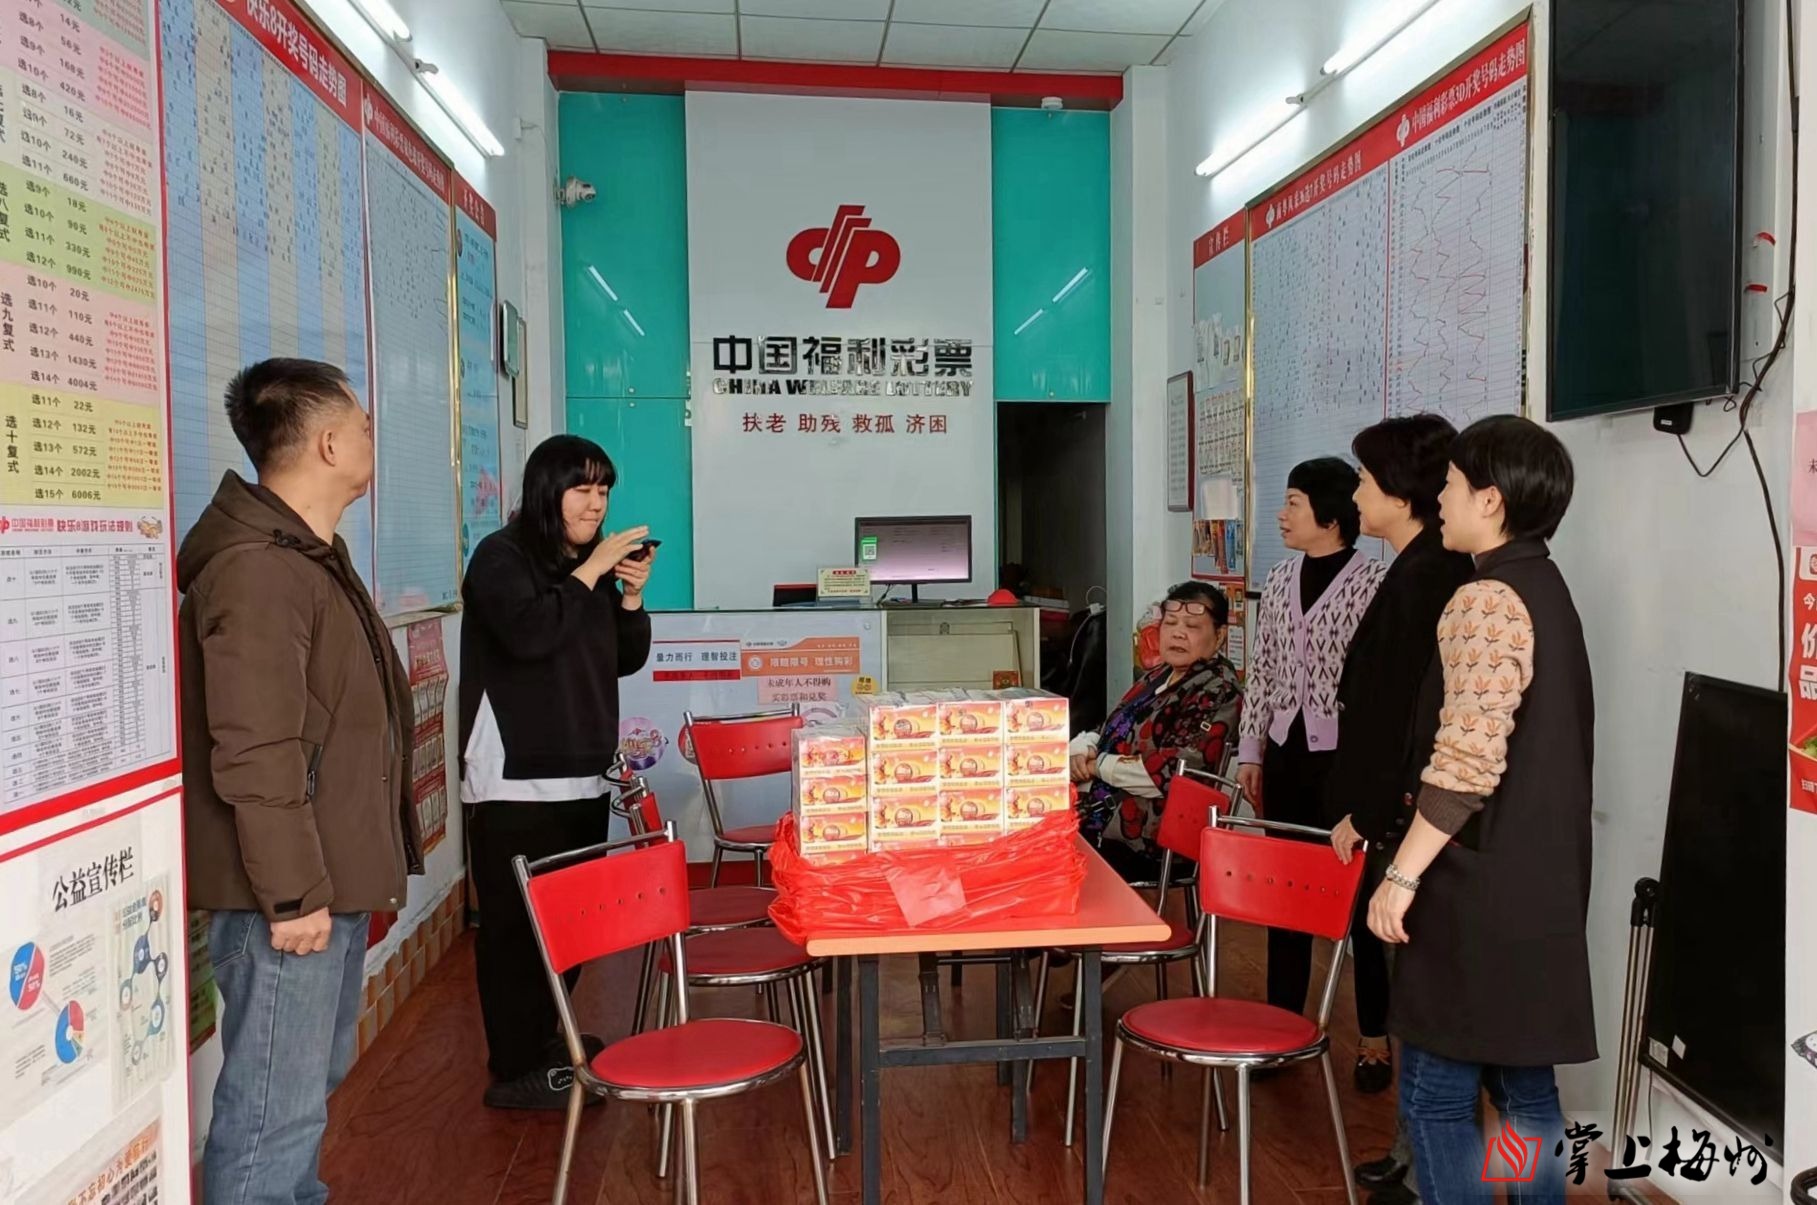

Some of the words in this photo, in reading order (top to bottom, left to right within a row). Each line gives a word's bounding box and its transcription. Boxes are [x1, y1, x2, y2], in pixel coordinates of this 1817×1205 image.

[60, 14, 80, 33] 14元
[61, 36, 82, 56] 56元
[18, 58, 49, 81] 选10个
[59, 58, 85, 79] 168元
[59, 82, 86, 102] 420元
[64, 105, 84, 123] 16元
[64, 128, 85, 146] 72元
[62, 150, 88, 169] 240元
[22, 154, 52, 175] 选11个
[63, 173, 89, 192] 660元
[67, 197, 87, 213] 18元
[24, 203, 54, 222] 选10个
[67, 220, 88, 236] 90元
[25, 227, 55, 245] 选11个
[26, 251, 56, 269] 选12个
[66, 264, 92, 281] 990元
[27, 274, 57, 292] 选10个
[69, 288, 90, 302] 20元
[28, 298, 58, 316] 选11个
[68, 310, 93, 325] 110元
[1, 291, 16, 353] 选九复式
[29, 322, 59, 339] 选12个
[69, 333, 94, 347] 440元
[30, 346, 60, 362] 选13个
[67, 354, 97, 370] 1430元
[712, 335, 973, 378] 中国福利彩票
[31, 370, 61, 385] 选14个
[67, 378, 98, 392] 4004元
[712, 378, 781, 396] CHINA
[31, 394, 62, 408] 选11个
[73, 400, 94, 413] 22元
[32, 417, 62, 431] 选12个
[72, 422, 97, 436] 132元
[742, 412, 786, 433] 扶老
[798, 412, 841, 433] 助残
[852, 413, 895, 434] 救孤
[905, 414, 948, 434] 济困
[5, 415, 20, 474] 选十复式
[33, 441, 63, 455] 选13个
[72, 445, 98, 458] 572元
[34, 464, 64, 477] 选14个
[70, 467, 101, 479] 2002元
[34, 487, 64, 500] 选15个
[71, 490, 102, 501] 6006元
[656, 652, 693, 663] 量力而行
[701, 651, 738, 662] 理智投注
[768, 677, 832, 688] 未成年人不得购
[52, 846, 134, 913] 公益宣传栏
